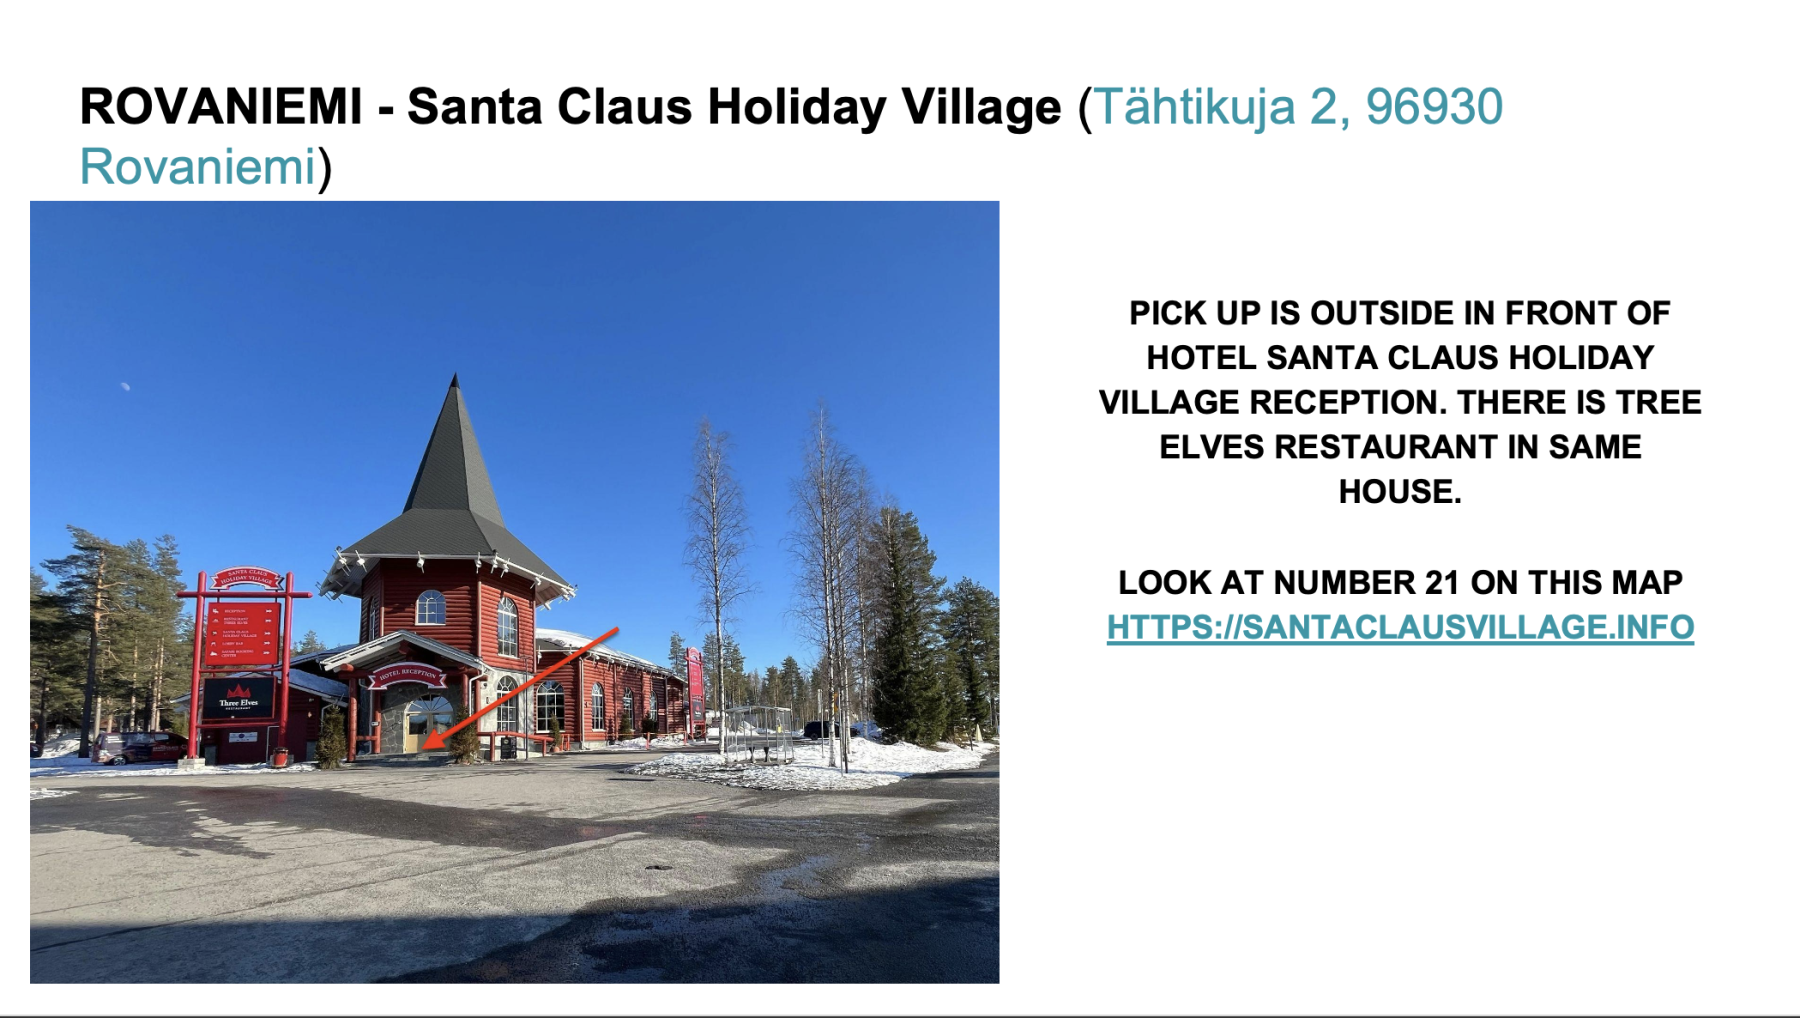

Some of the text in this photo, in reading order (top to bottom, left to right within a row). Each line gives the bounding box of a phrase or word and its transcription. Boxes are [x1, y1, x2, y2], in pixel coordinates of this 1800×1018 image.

[249, 569, 268, 577] CLAUS
[221, 576, 272, 584] HOLIDAY VILLAGE
[380, 668, 436, 680] HOTEL RECEPTION
